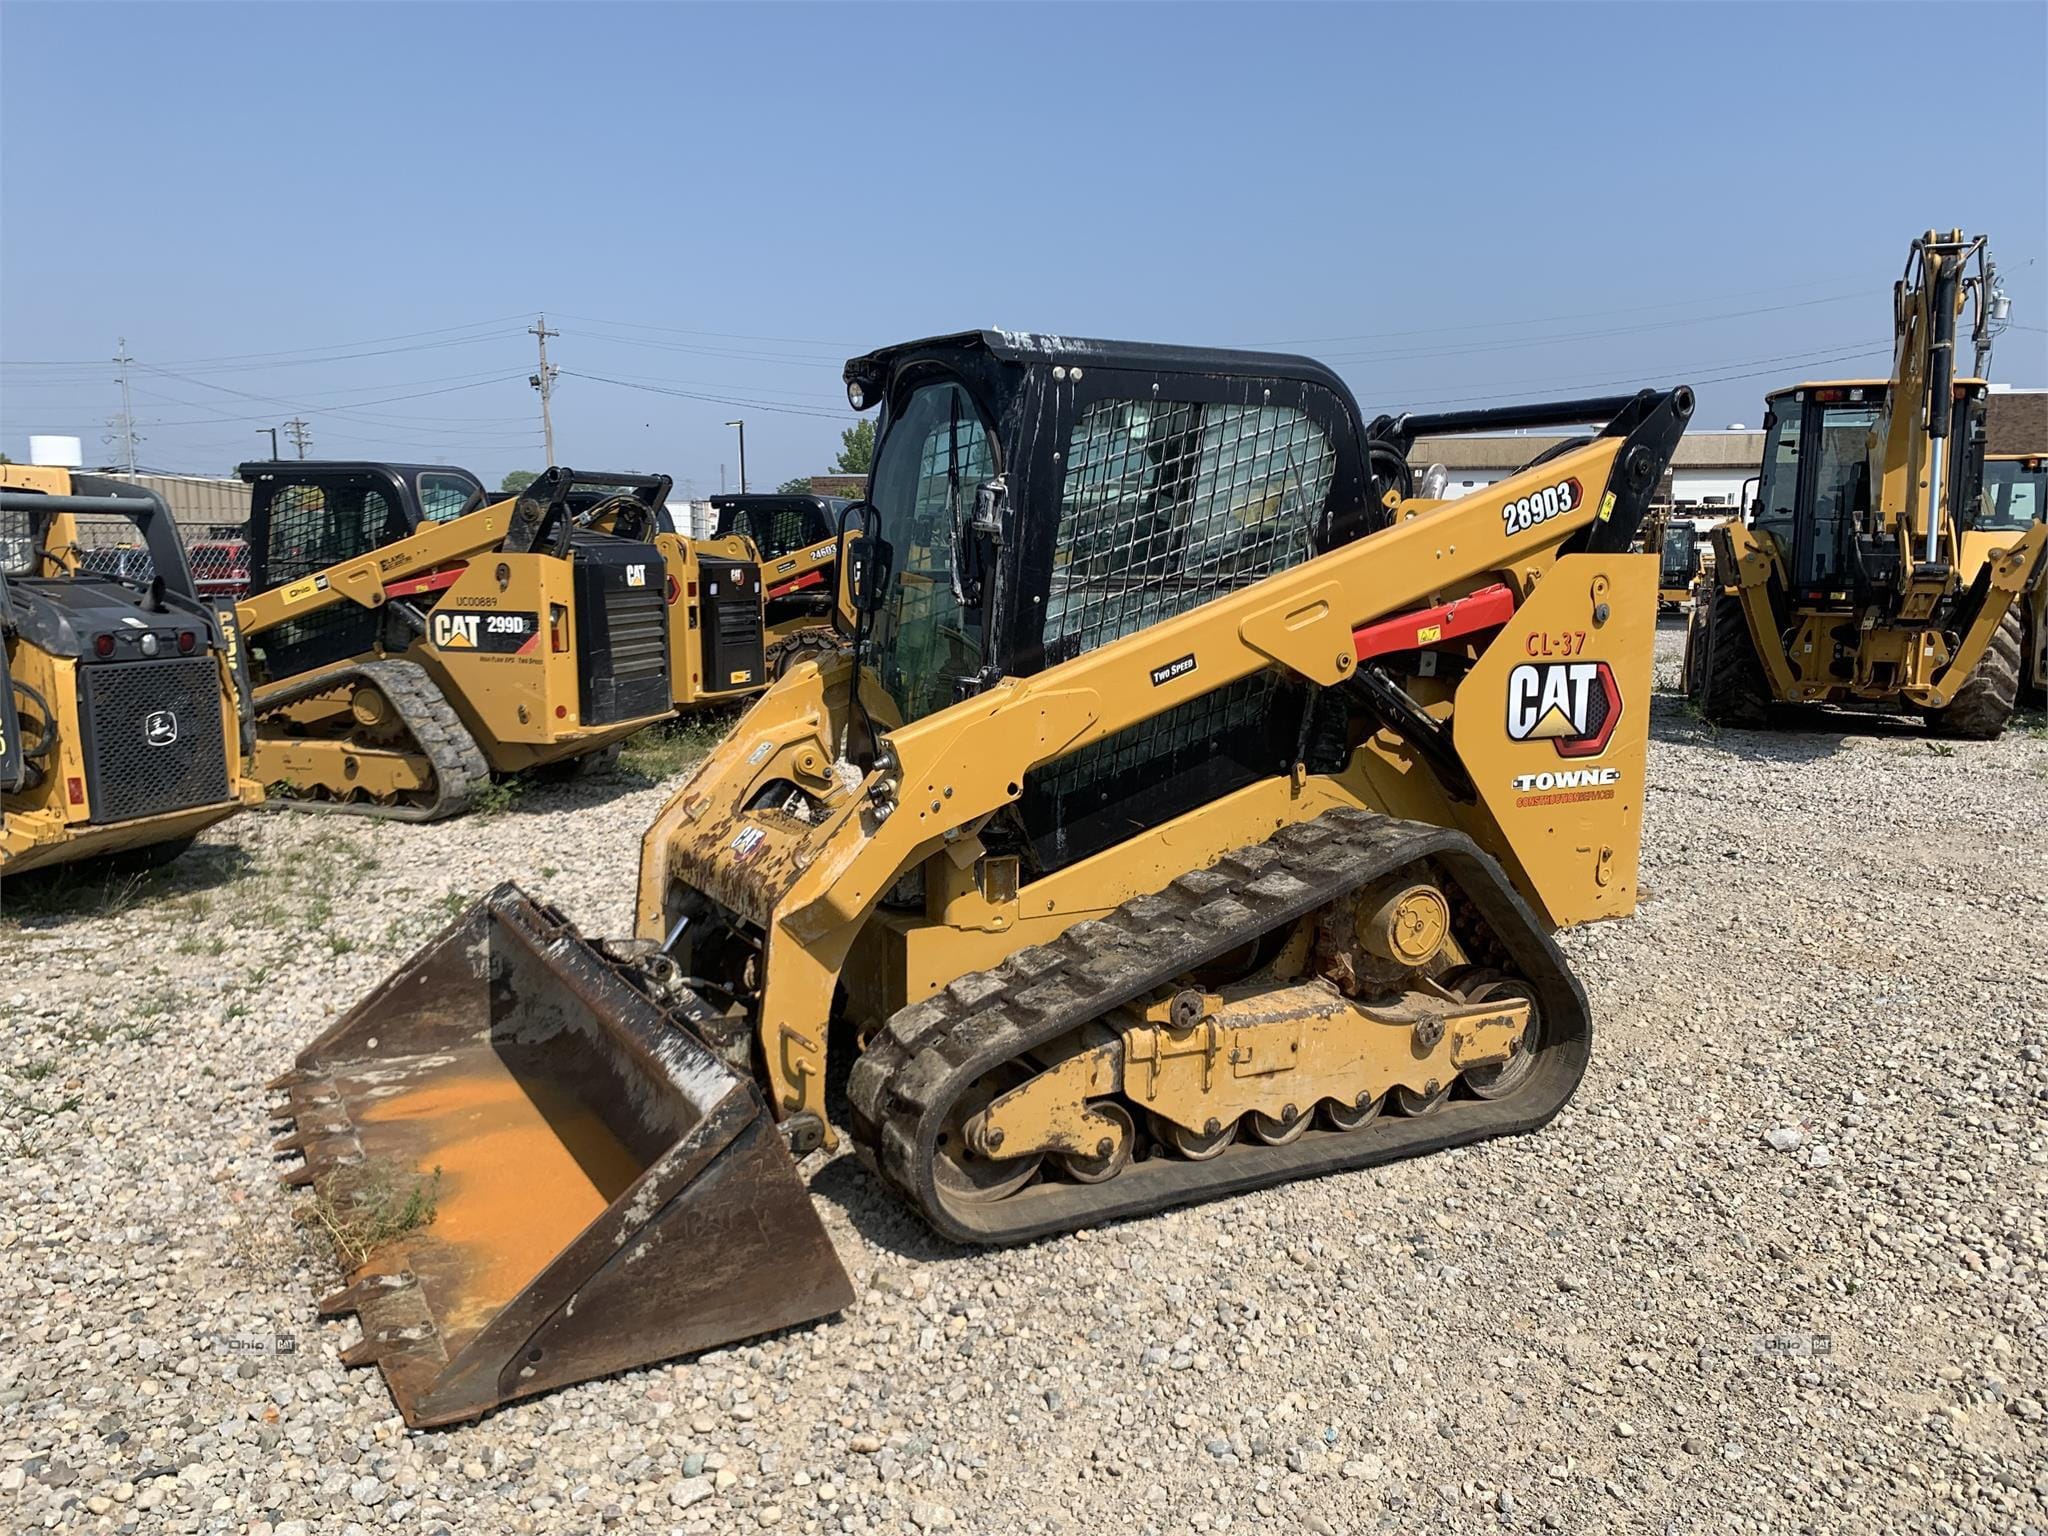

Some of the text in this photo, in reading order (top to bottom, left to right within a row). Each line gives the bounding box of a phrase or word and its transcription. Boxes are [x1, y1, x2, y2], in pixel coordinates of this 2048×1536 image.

[1503, 481, 1572, 535] 289D3
[810, 543, 837, 561] 246D3
[626, 564, 646, 586] CAT
[435, 614, 531, 648] CAT 299D2
[1526, 631, 1586, 657] CL-37
[1508, 663, 1597, 739] CAT
[1517, 767, 1616, 792] TOWNE
[730, 825, 767, 854] CAT
